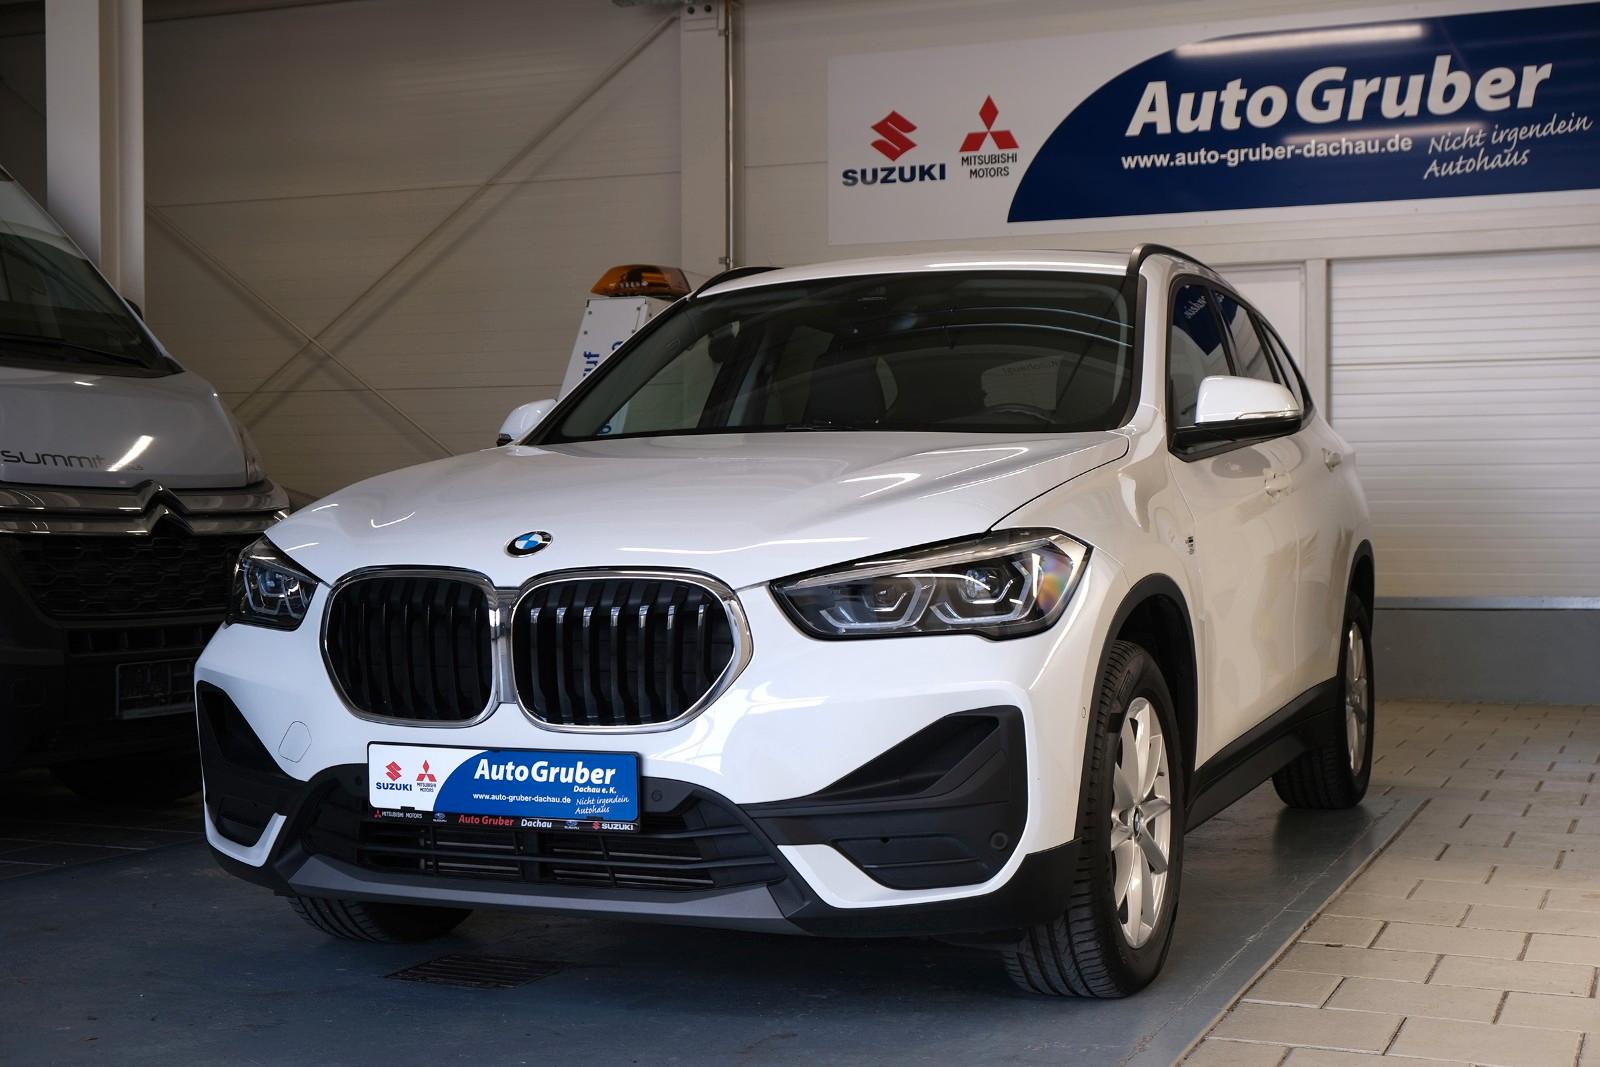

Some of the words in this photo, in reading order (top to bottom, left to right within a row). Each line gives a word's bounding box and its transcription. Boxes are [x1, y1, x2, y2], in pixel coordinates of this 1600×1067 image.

[1428, 126, 1487, 154] Nicht
[1491, 112, 1593, 153] irgendein
[1121, 134, 1413, 170] www.auto-gruber-dachau.de
[961, 152, 1018, 167] MITSUBISHI
[1423, 148, 1531, 180] Autohaus
[842, 163, 946, 187] SUZUKI
[969, 166, 1010, 180] MOTORS
[376, 782, 412, 791] SUZUKI
[574, 785, 601, 793] Dachau
[473, 793, 571, 803] www.auto-gruber-dachau.de
[576, 797, 595, 806] Nicht
[596, 795, 630, 808] irgendein
[574, 804, 610, 815] Autohaus
[459, 815, 480, 824] Auto
[481, 815, 514, 826] Gruber
[521, 818, 552, 829] Dachau
[601, 823, 634, 831] SUZUKI
